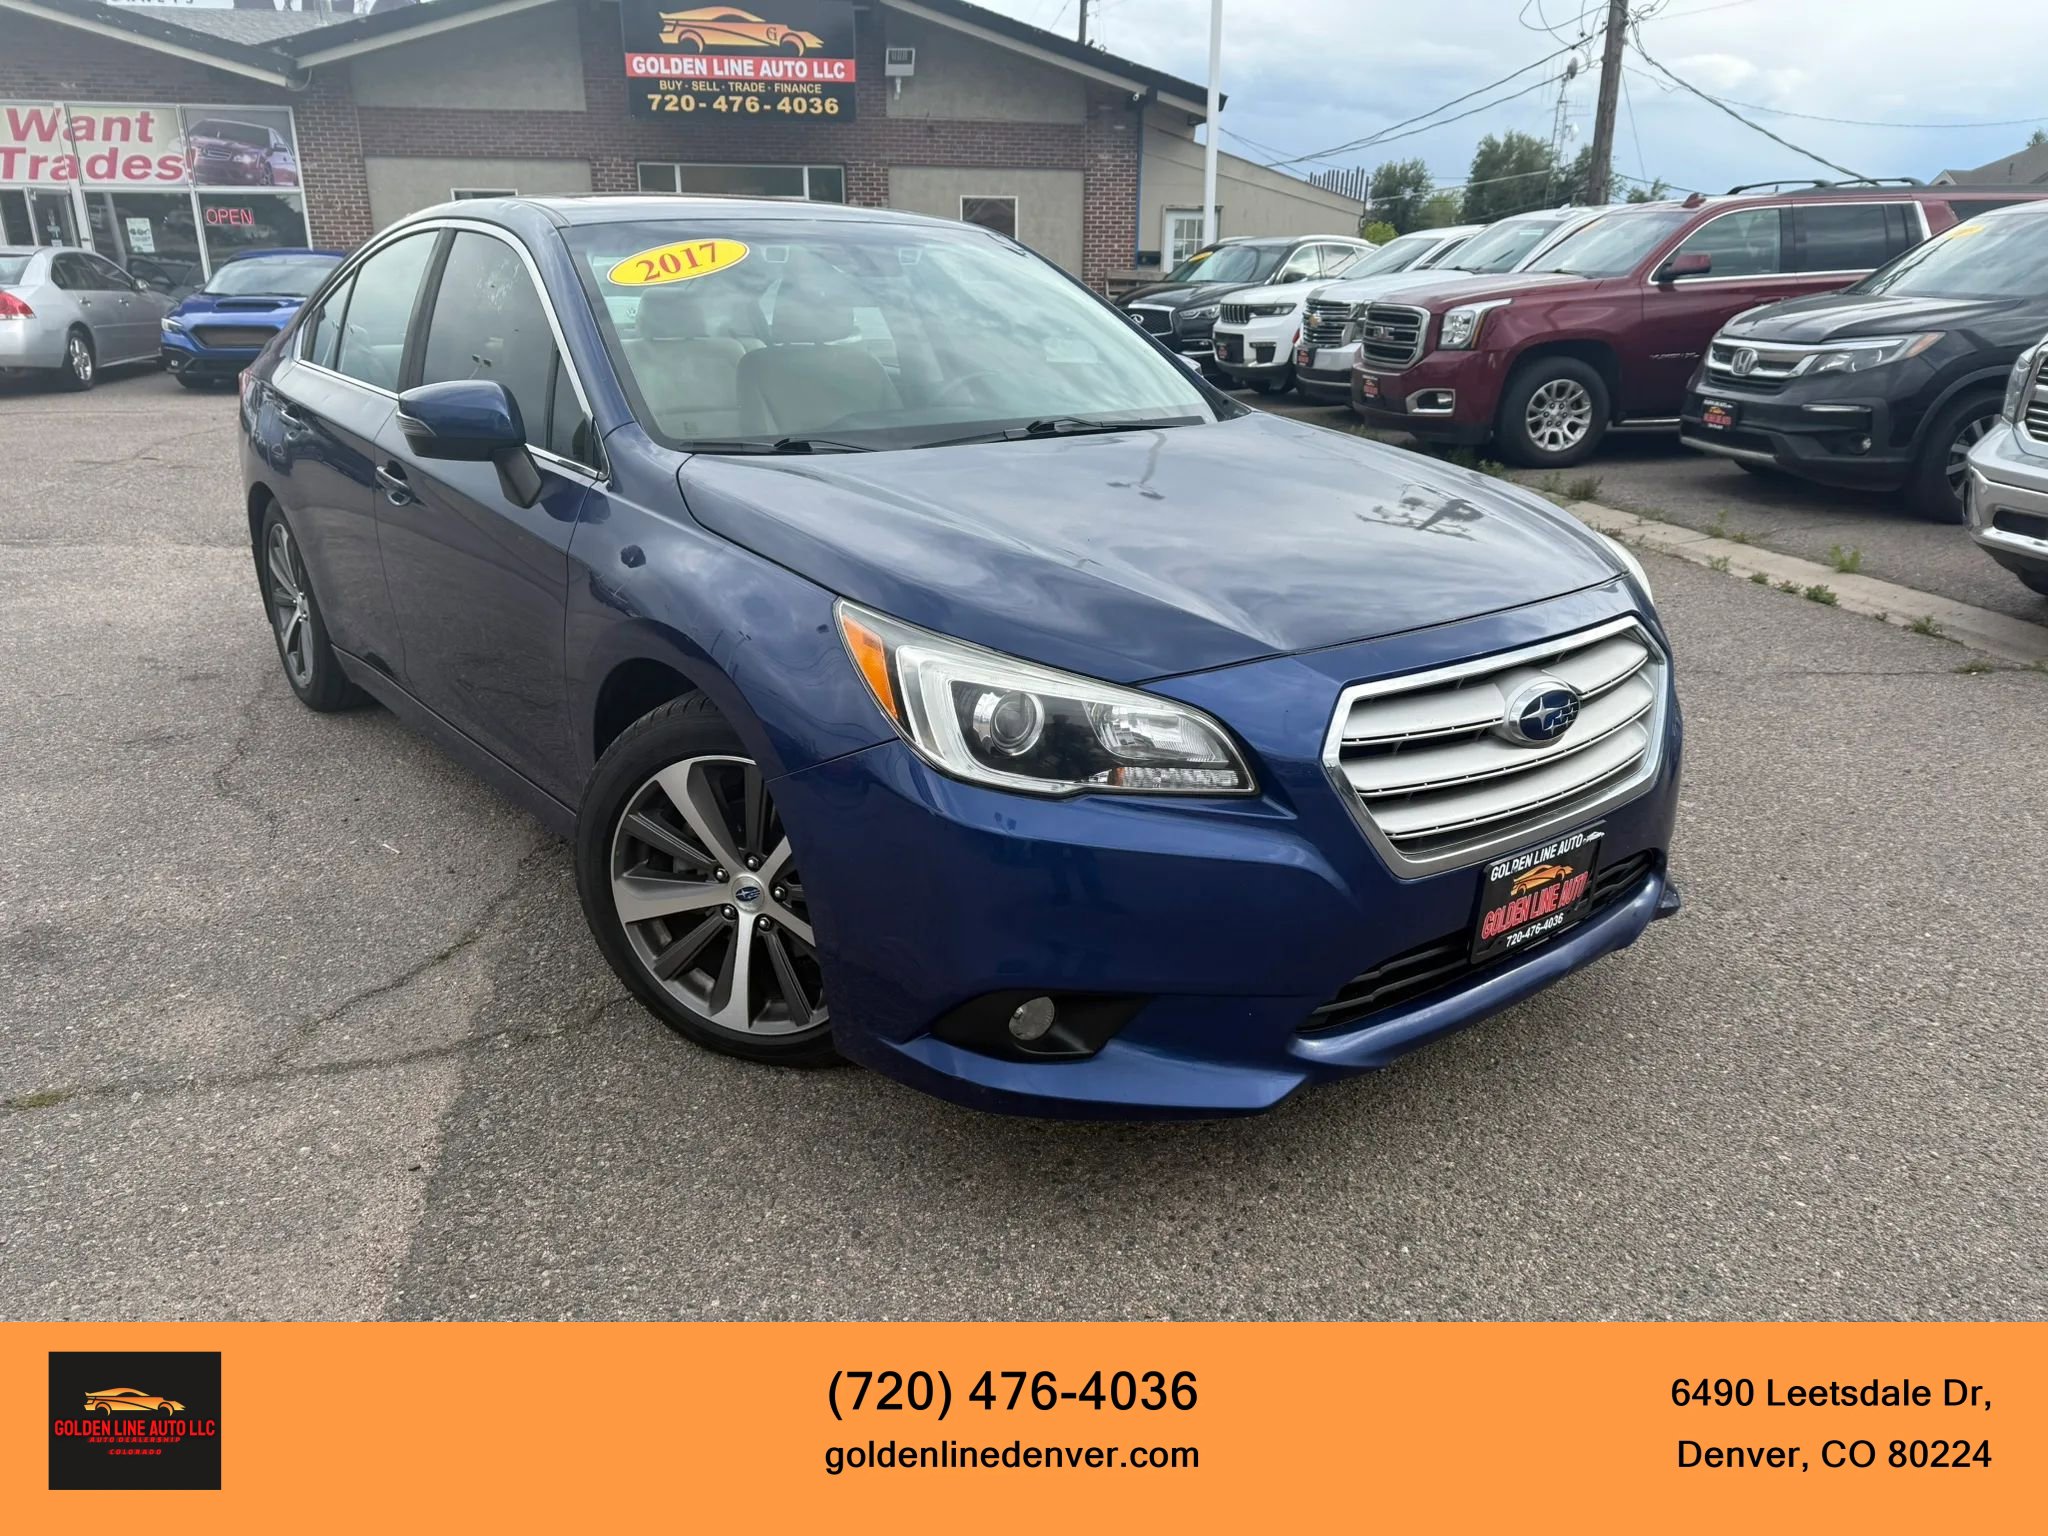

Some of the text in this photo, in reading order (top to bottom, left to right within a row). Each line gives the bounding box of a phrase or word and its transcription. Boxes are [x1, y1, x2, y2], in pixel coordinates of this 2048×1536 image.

[632, 56, 846, 79] GOLDEN LINE AUTO LLC
[659, 80, 823, 94] BUY SELL TRADE FINANCE
[6, 108, 155, 143] Want
[206, 209, 254, 225] OPEN
[635, 242, 717, 281] 2017
[1534, 843, 1558, 865] LINE
[1557, 833, 1584, 856] AUTO
[1481, 895, 1532, 940] GOLDEN
[1529, 882, 1561, 920] LINE
[1506, 912, 1564, 948] 720-476-4036
